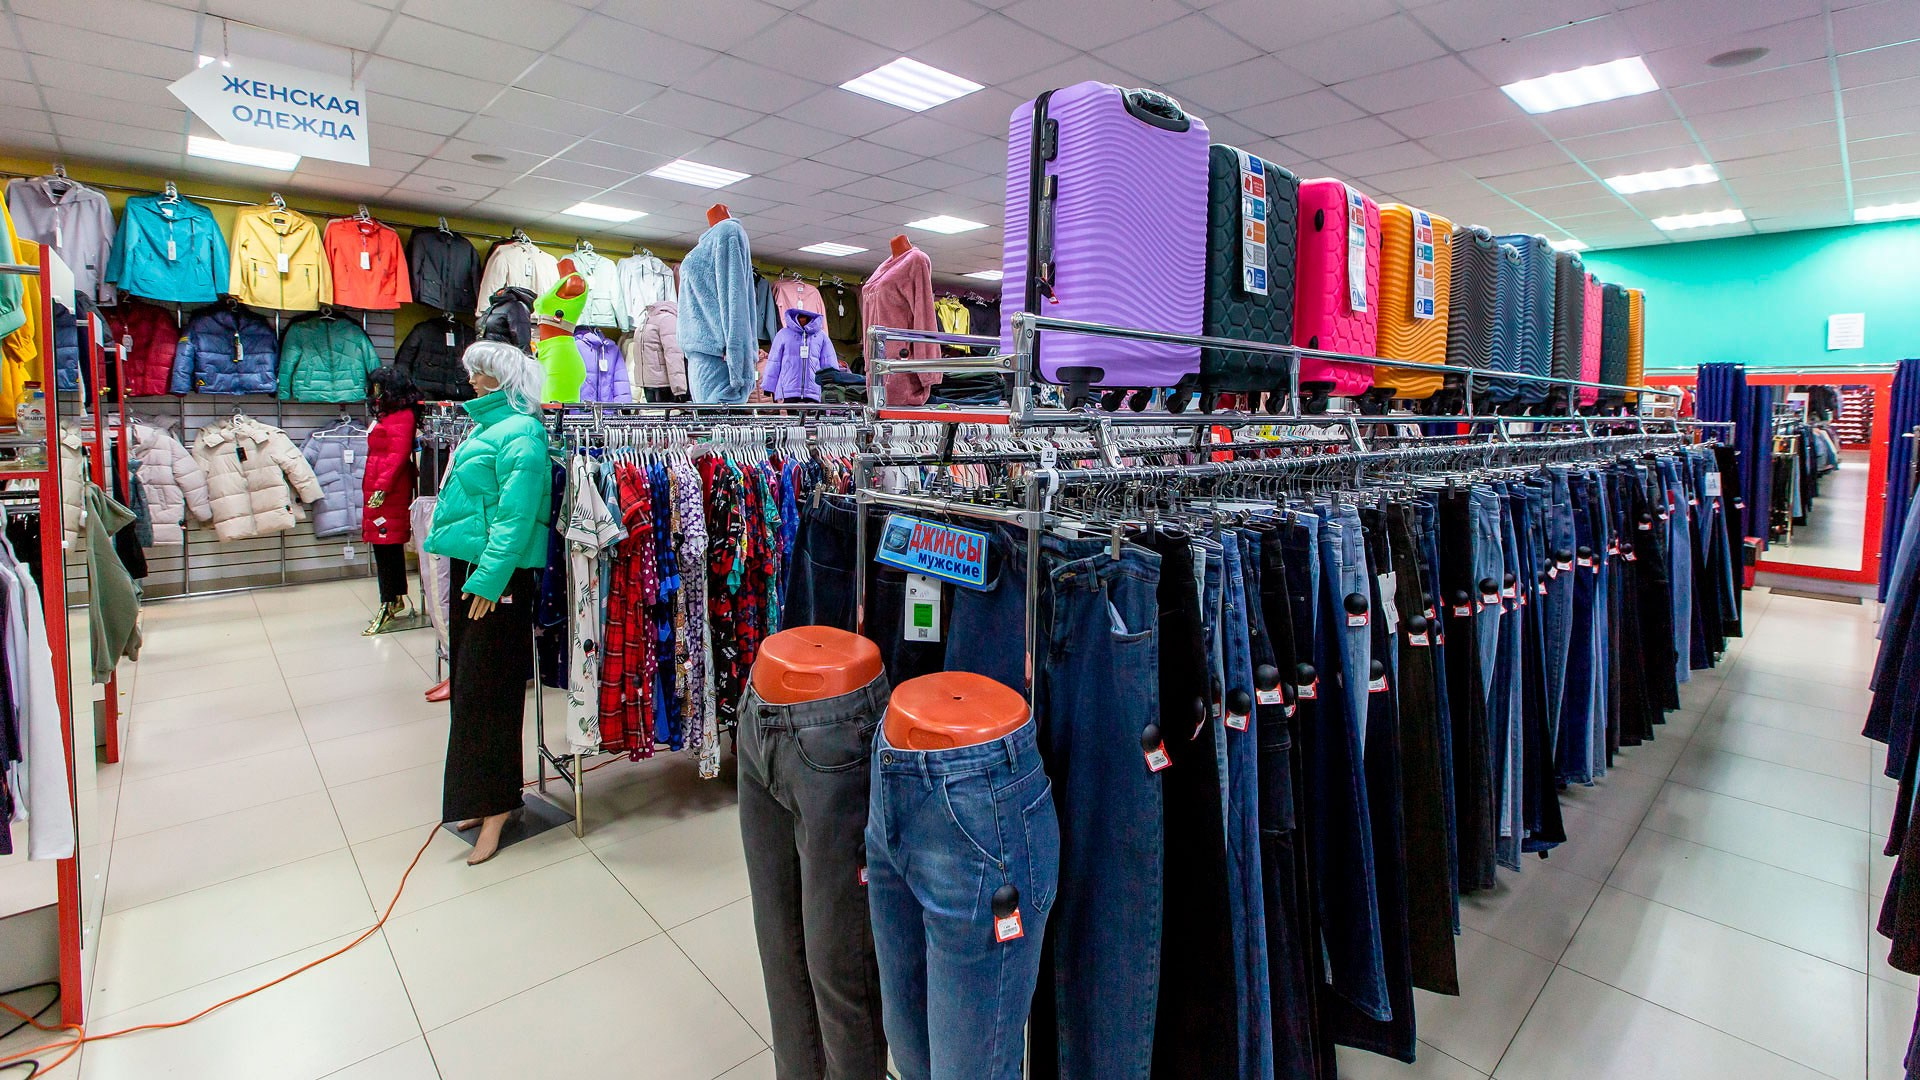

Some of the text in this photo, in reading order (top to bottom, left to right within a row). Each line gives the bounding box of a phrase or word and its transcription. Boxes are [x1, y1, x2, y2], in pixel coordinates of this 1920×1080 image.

[222, 75, 360, 116] ЖЕНСКАЯ
[232, 105, 356, 140] ОДЕЖДА
[909, 523, 983, 563] ДЖИНСЫ
[918, 552, 980, 578] мужские
